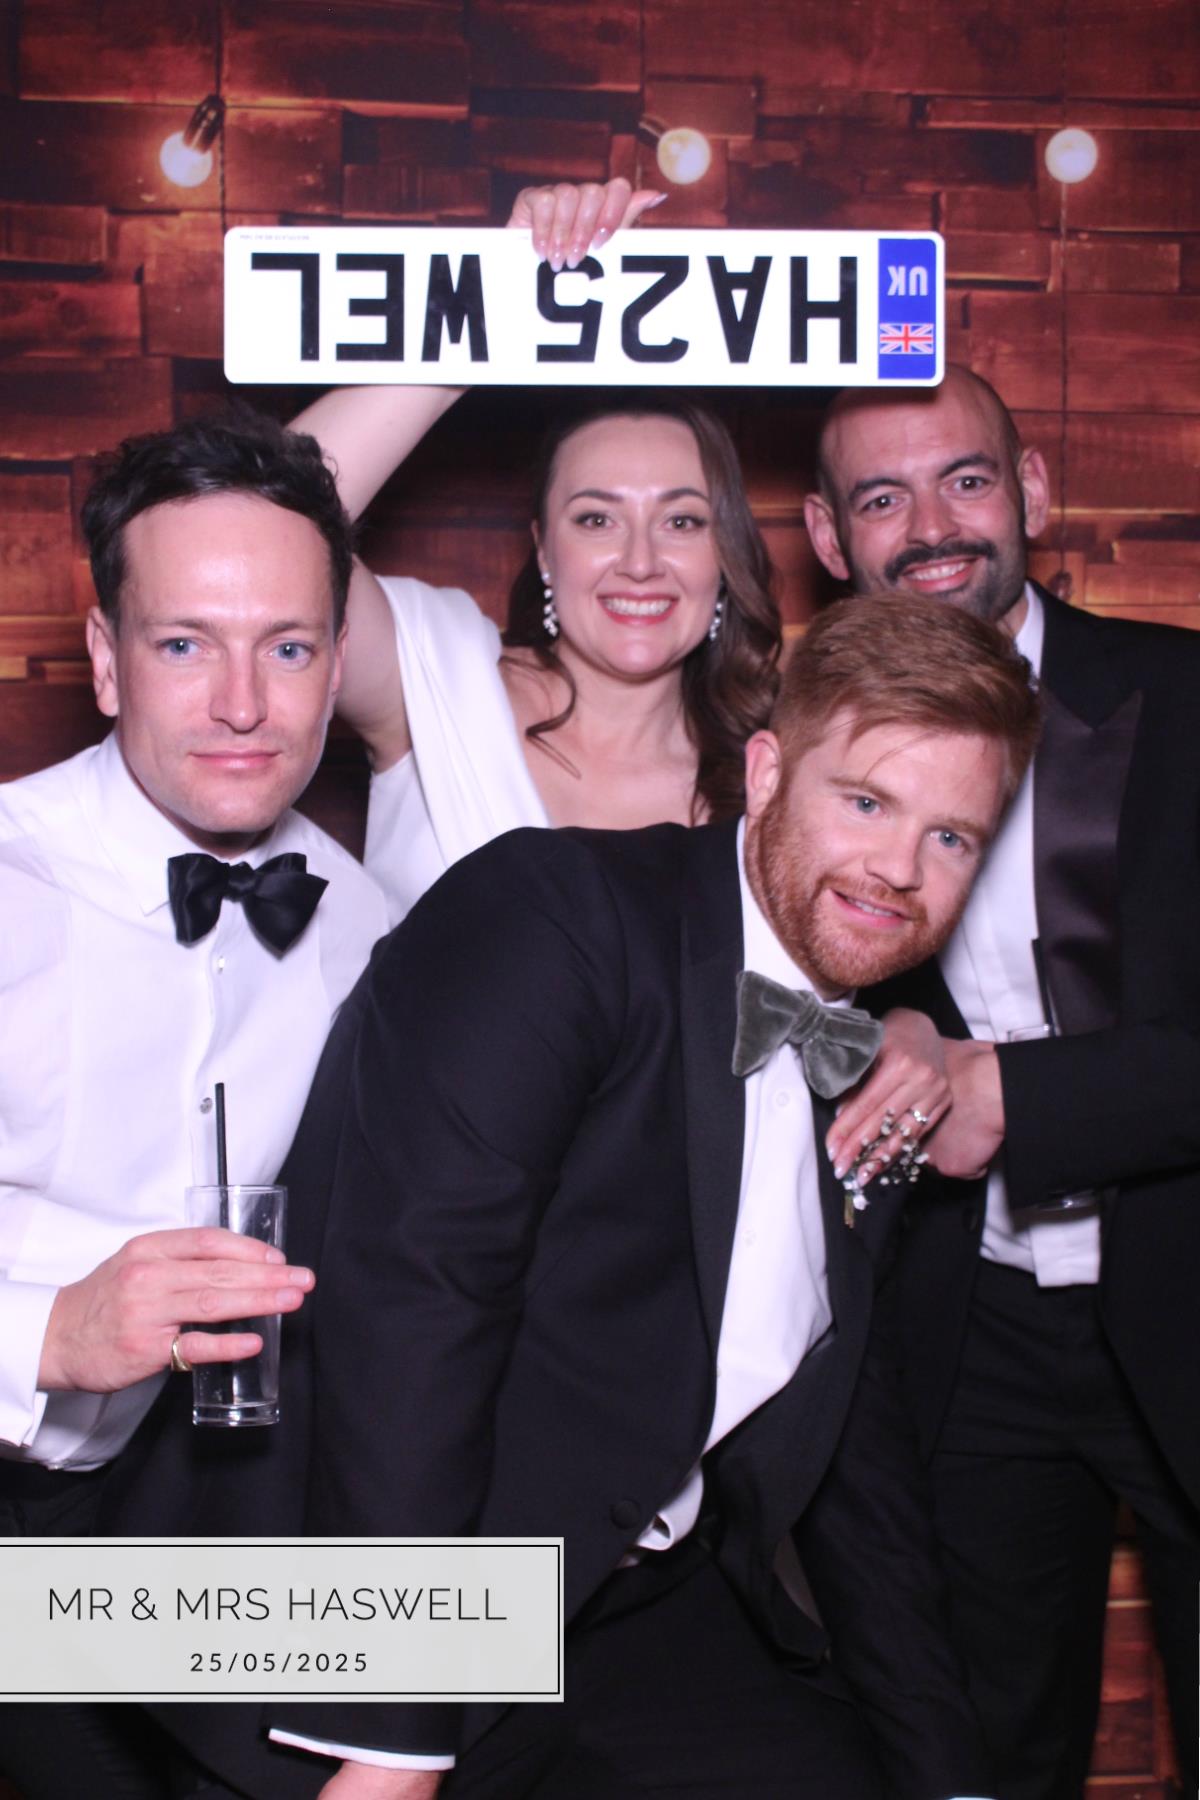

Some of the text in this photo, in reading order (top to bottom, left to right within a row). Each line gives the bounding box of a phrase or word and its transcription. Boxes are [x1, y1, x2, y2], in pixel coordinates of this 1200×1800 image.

[250, 252, 858, 364] HA25 WEL
[888, 265, 928, 297] UK
